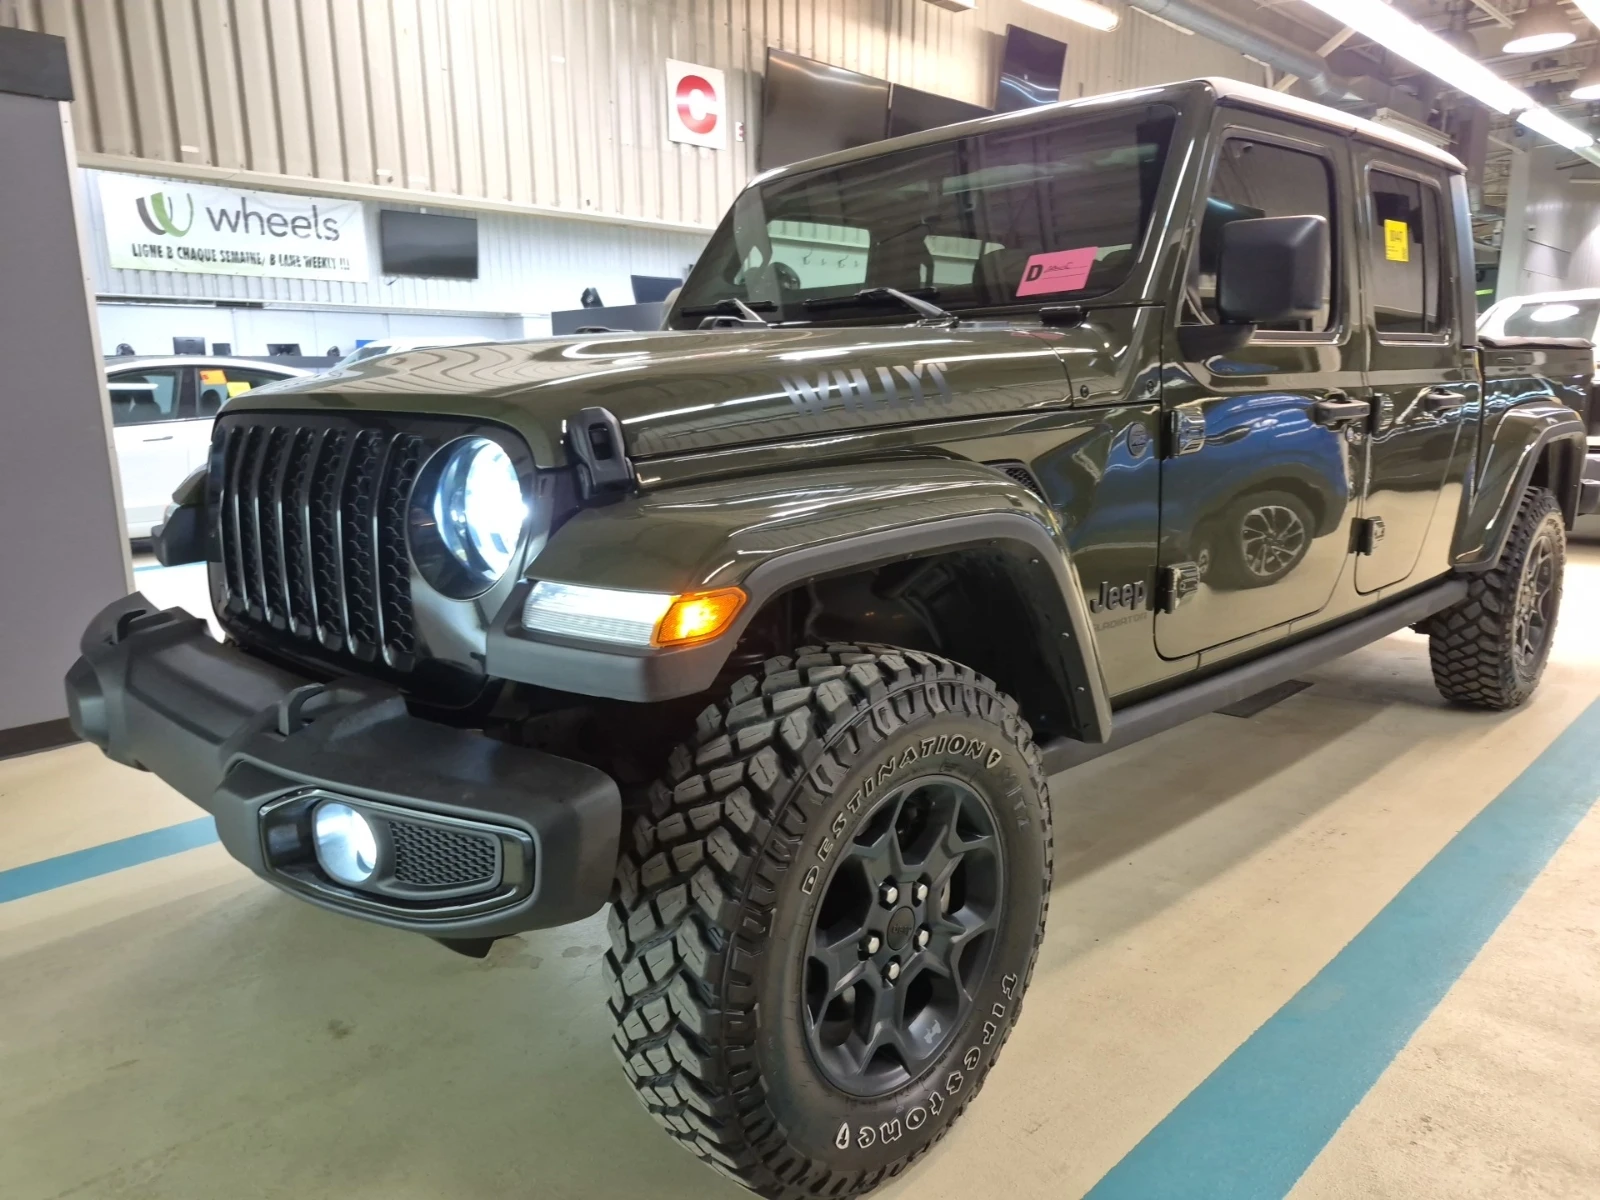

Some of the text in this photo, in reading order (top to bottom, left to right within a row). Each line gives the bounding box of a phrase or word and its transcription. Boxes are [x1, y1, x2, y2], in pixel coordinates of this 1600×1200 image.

[205, 197, 340, 242] wheels
[132, 243, 163, 258] LIGNE
[177, 246, 217, 262] CHAQUE
[1025, 264, 1043, 282] D
[1089, 580, 1146, 614] Jeep
[801, 734, 986, 895] DESTINATION
[857, 972, 1018, 1149] Firestone
